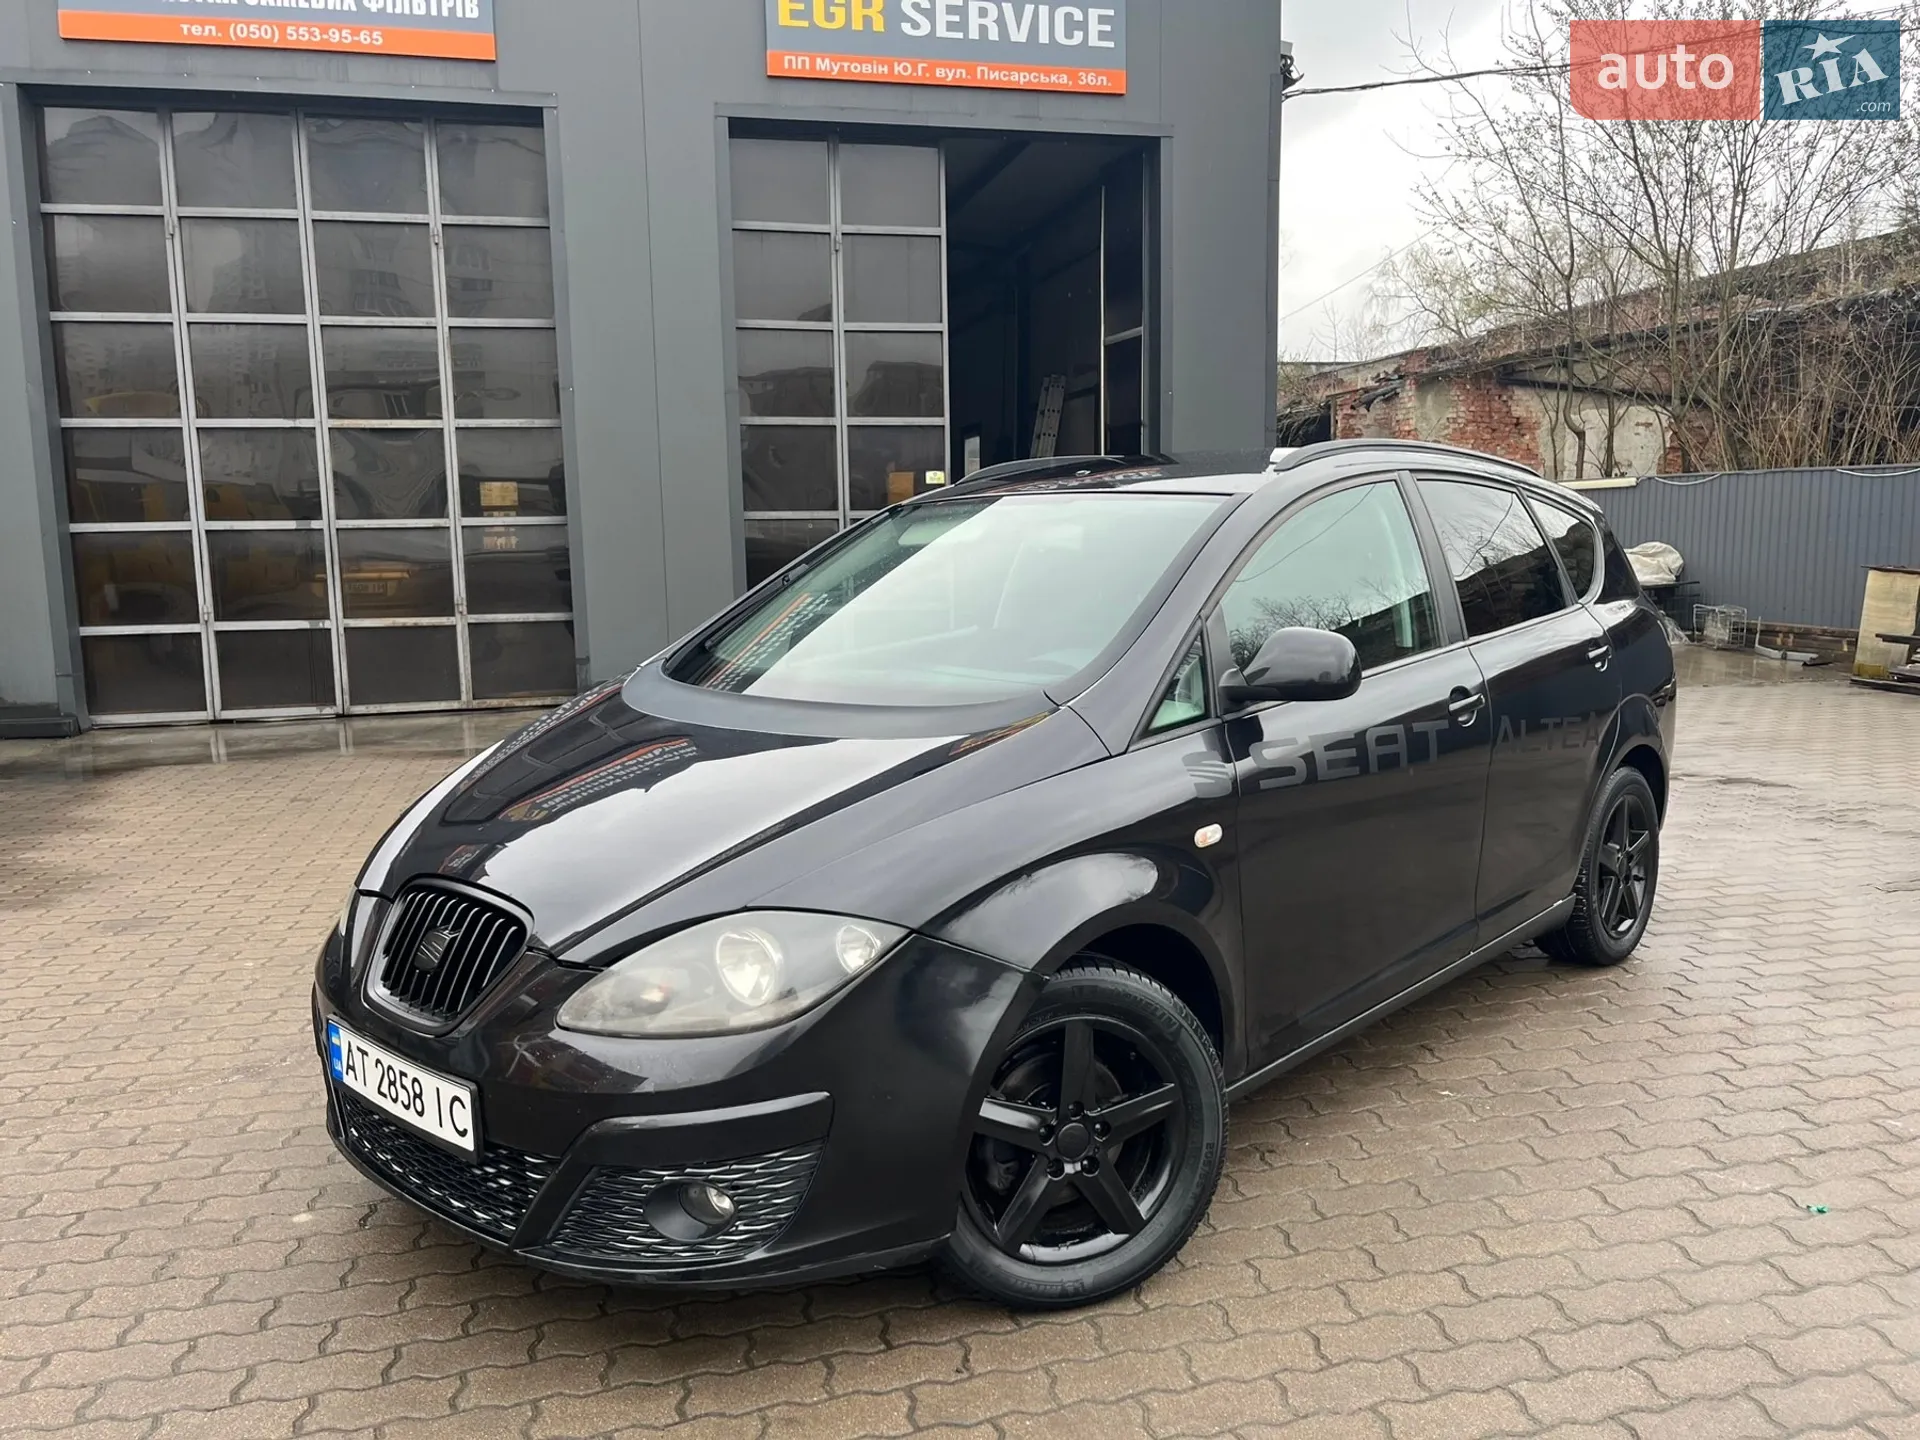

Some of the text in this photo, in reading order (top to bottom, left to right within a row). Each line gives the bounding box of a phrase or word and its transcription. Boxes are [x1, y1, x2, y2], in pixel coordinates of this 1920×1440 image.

[180, 23, 384, 46] тел. (050) 553-95-65
[778, 0, 1115, 48] EGR SERVICE
[783, 55, 810, 70] ПП
[816, 57, 889, 75] Мутовін
[935, 67, 972, 82] вул.
[977, 66, 1073, 86] Писарська,
[1249, 711, 1600, 790] SEAT ALTEA
[345, 1040, 468, 1138] AT 2858 IC
